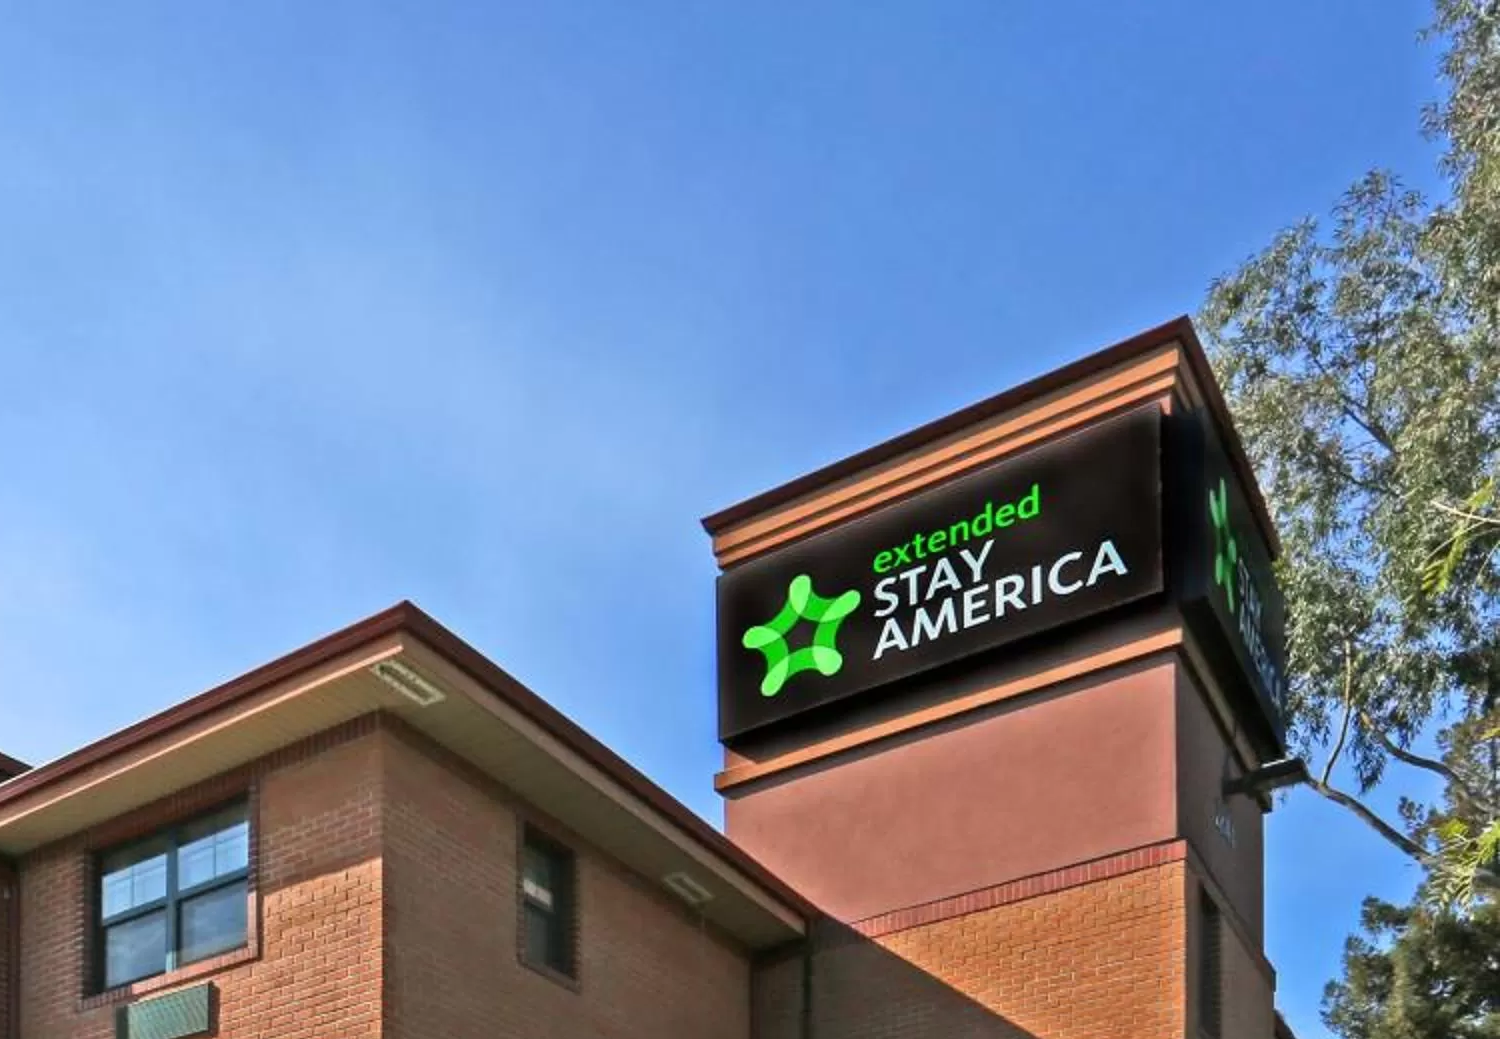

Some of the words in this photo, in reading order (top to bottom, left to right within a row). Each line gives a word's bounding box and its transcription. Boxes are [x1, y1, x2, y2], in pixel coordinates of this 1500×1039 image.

[873, 483, 1040, 573] extended
[872, 540, 1128, 661] AMERICA
[873, 539, 994, 617] STAY
